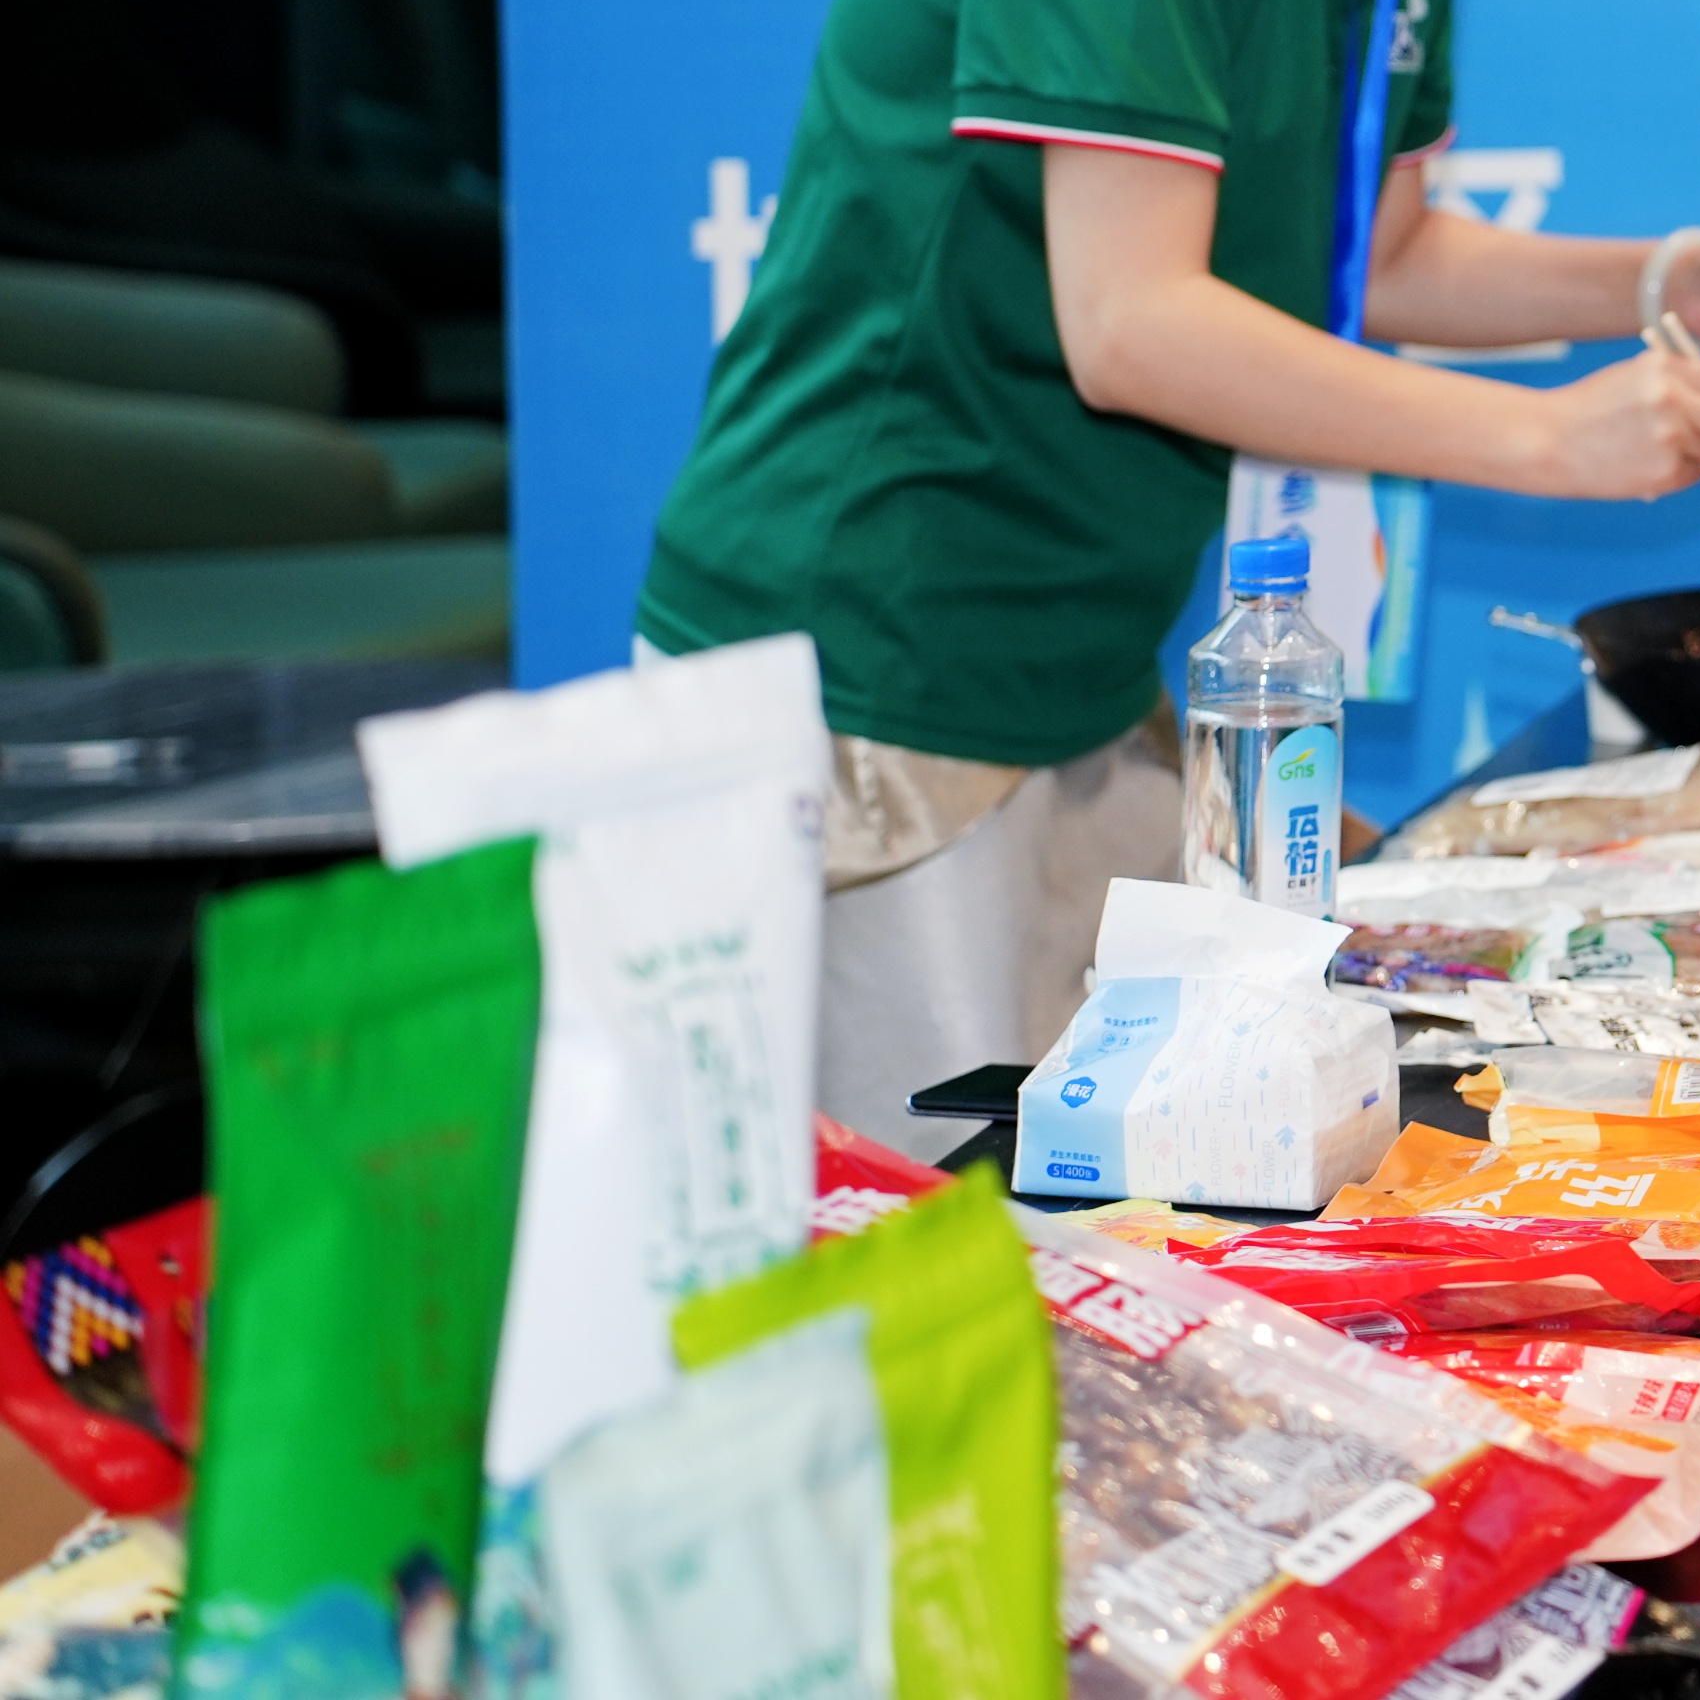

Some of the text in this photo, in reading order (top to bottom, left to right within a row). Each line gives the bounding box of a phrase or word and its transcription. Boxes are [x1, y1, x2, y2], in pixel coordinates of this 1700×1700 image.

[1217, 1040, 1244, 1110] FLOWER
[1064, 1166, 1094, 1180] 400张
[1209, 1135, 1223, 1188] FLOWER
[1262, 1139, 1276, 1193] FLOWER
